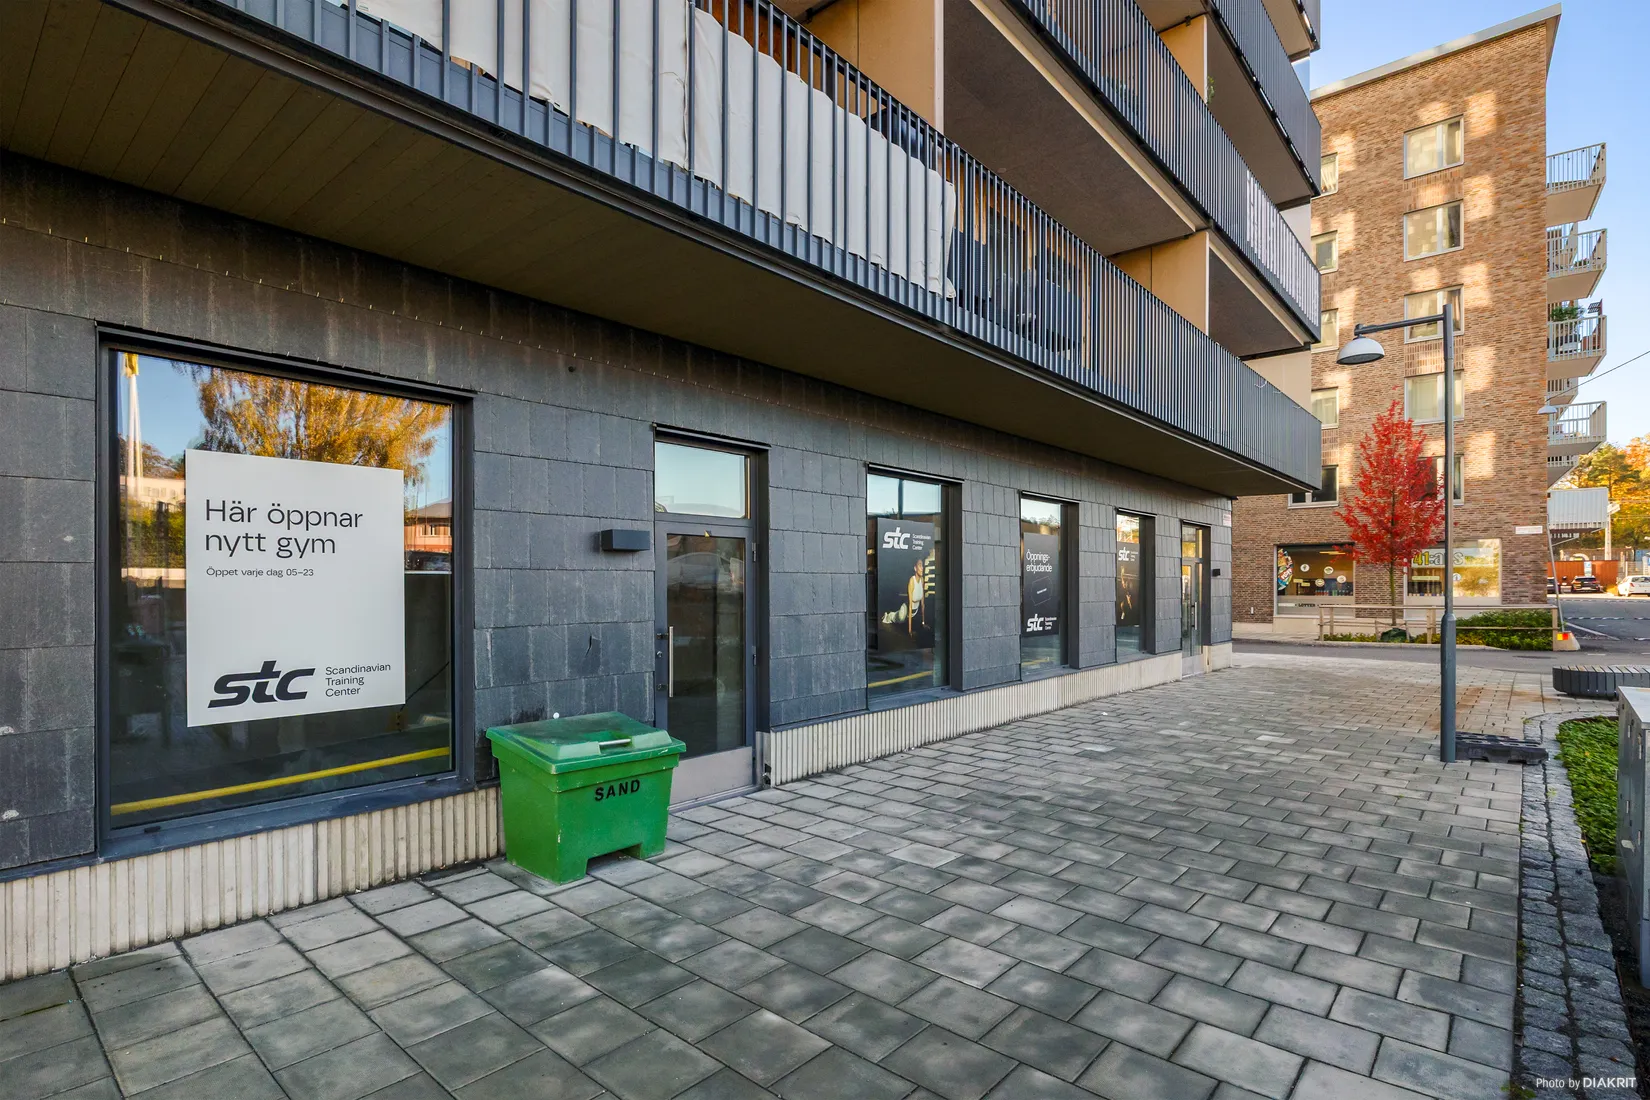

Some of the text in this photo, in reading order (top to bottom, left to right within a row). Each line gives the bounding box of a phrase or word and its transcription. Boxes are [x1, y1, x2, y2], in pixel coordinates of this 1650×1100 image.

[206, 499, 363, 531] Här öppnar
[205, 532, 336, 559] nytt gym
[882, 526, 911, 550] stc
[1026, 549, 1051, 564] Öppnings-
[206, 566, 238, 578] Öppet
[241, 568, 264, 578] varje
[266, 568, 284, 578] dag
[1026, 562, 1053, 574] erbjudande
[1026, 613, 1044, 632] stc
[325, 663, 391, 676] Scandinavian
[207, 660, 316, 708] stc
[325, 675, 365, 687] Training
[325, 686, 361, 698] Center
[594, 779, 641, 802] SAND
